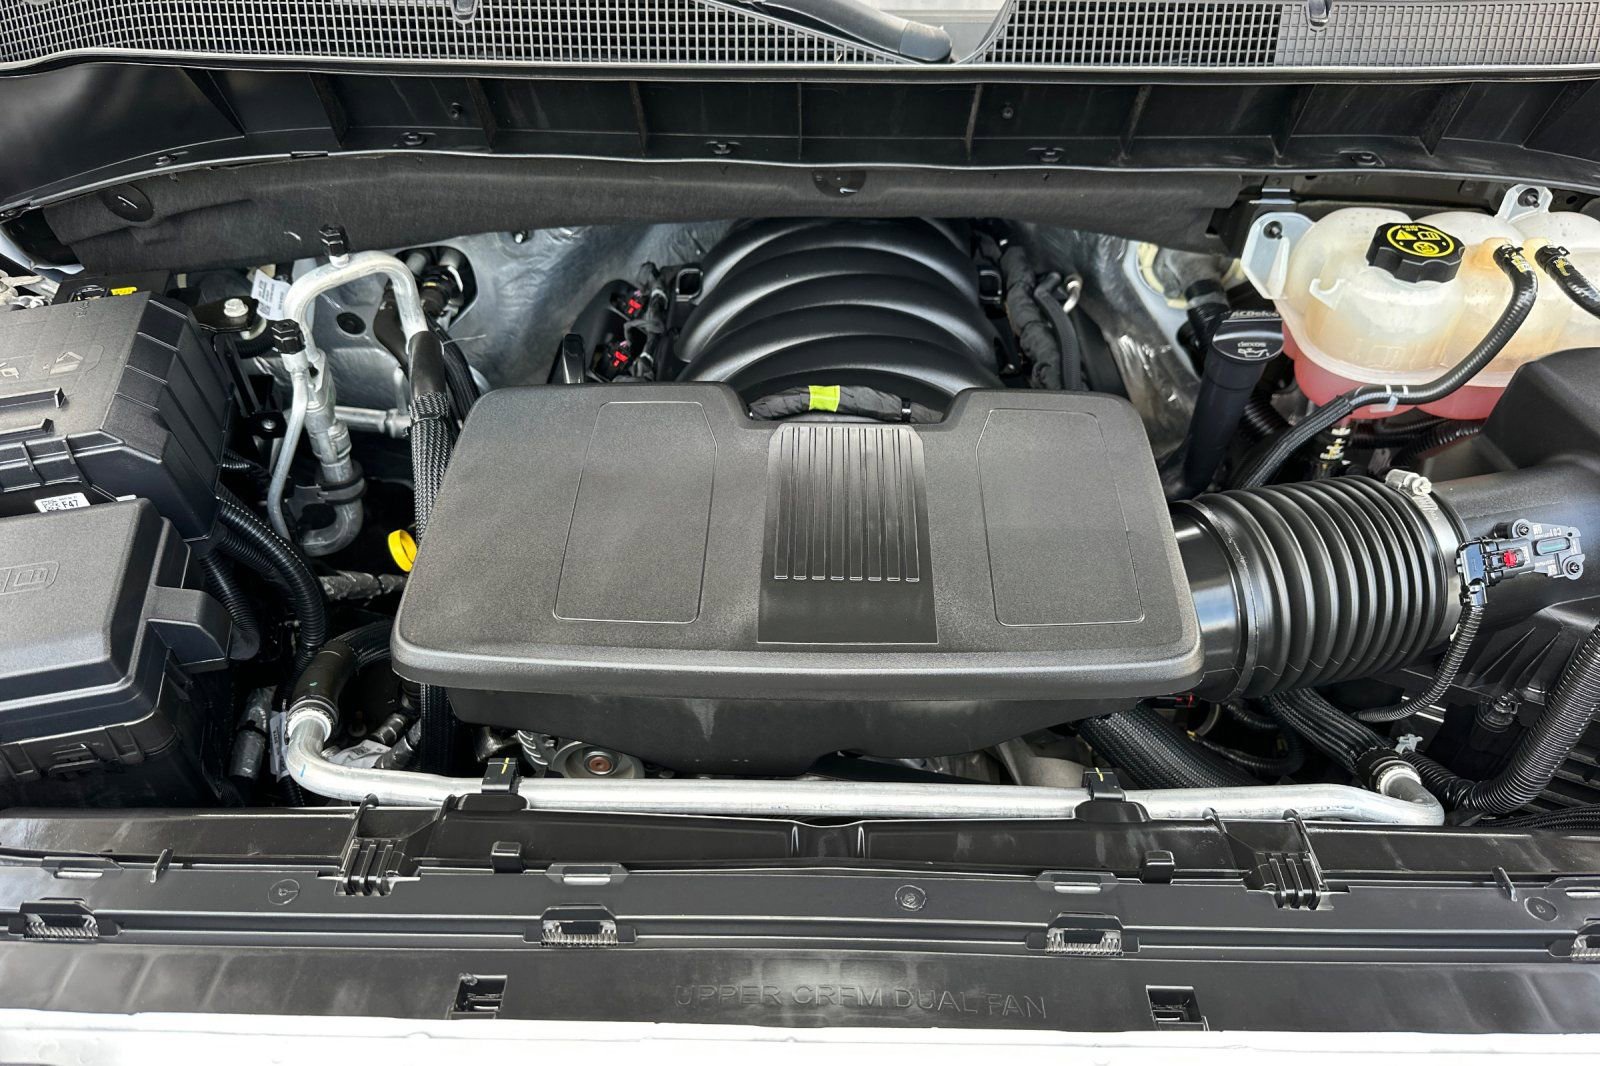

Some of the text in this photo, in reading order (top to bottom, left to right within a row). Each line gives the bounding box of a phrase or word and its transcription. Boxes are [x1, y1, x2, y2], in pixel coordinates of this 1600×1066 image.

[62, 500, 78, 508] F47
[675, 984, 785, 1007] UPPER
[895, 989, 979, 1014] DUAL
[984, 993, 1048, 1020] FAN
